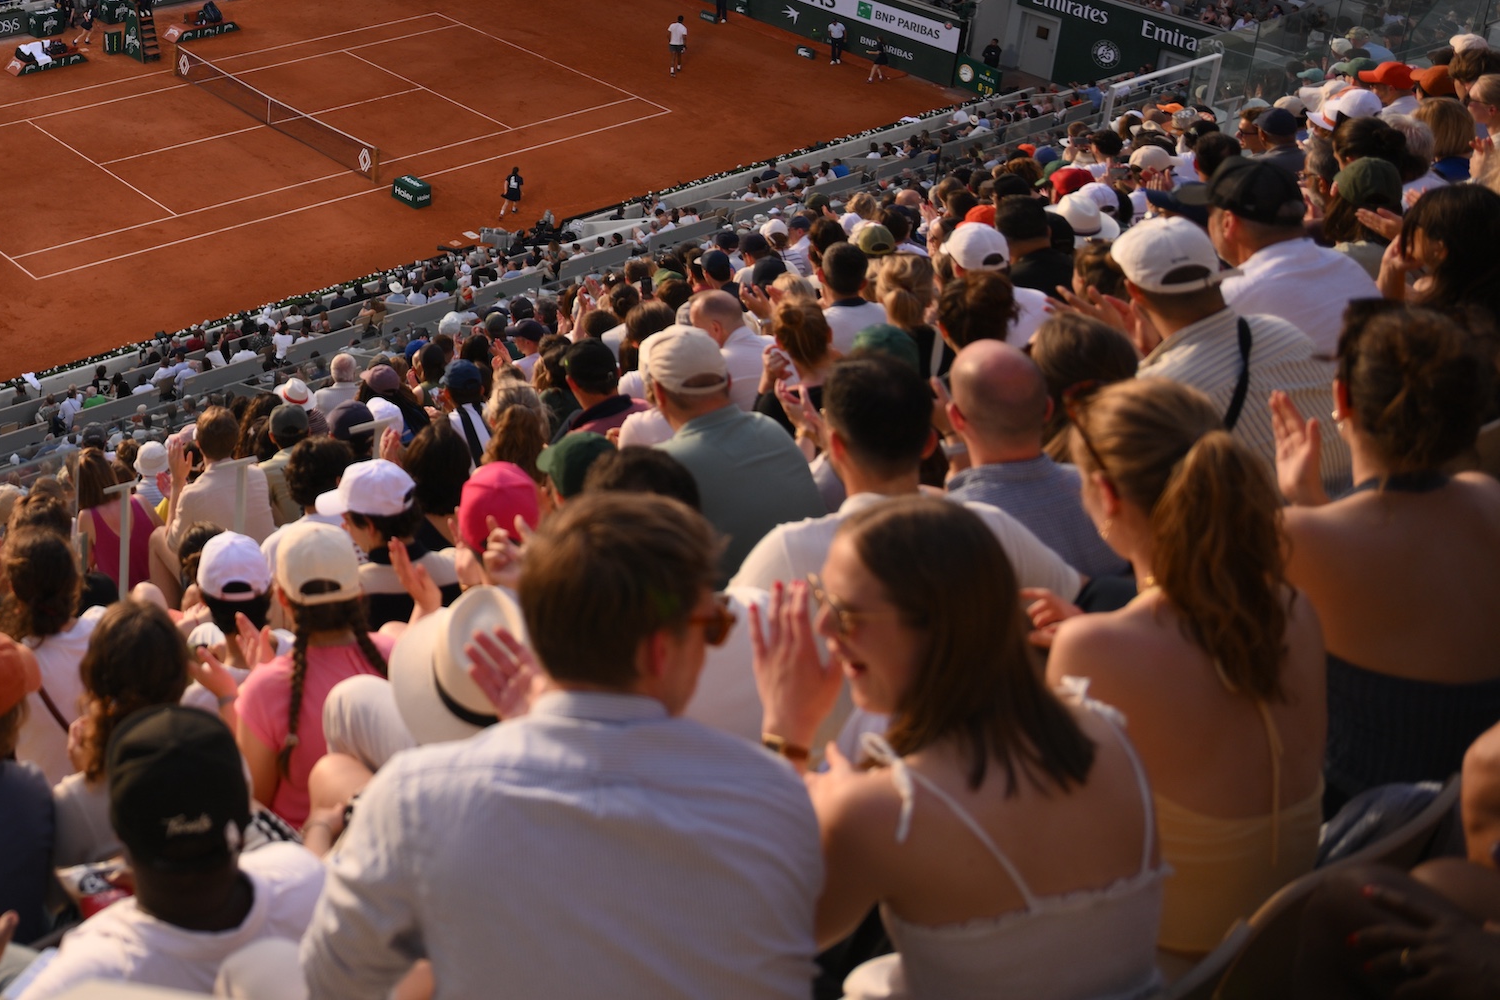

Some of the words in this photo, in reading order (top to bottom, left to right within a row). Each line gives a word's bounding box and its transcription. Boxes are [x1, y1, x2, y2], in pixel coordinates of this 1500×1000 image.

[875, 10, 896, 24] BNP
[898, 18, 941, 40] PARIBAS
[860, 36, 878, 48] BNP
[882, 44, 914, 61] ARIBAS
[401, 176, 423, 187] Haier
[395, 186, 414, 201] Haier
[417, 193, 431, 202] Haier
